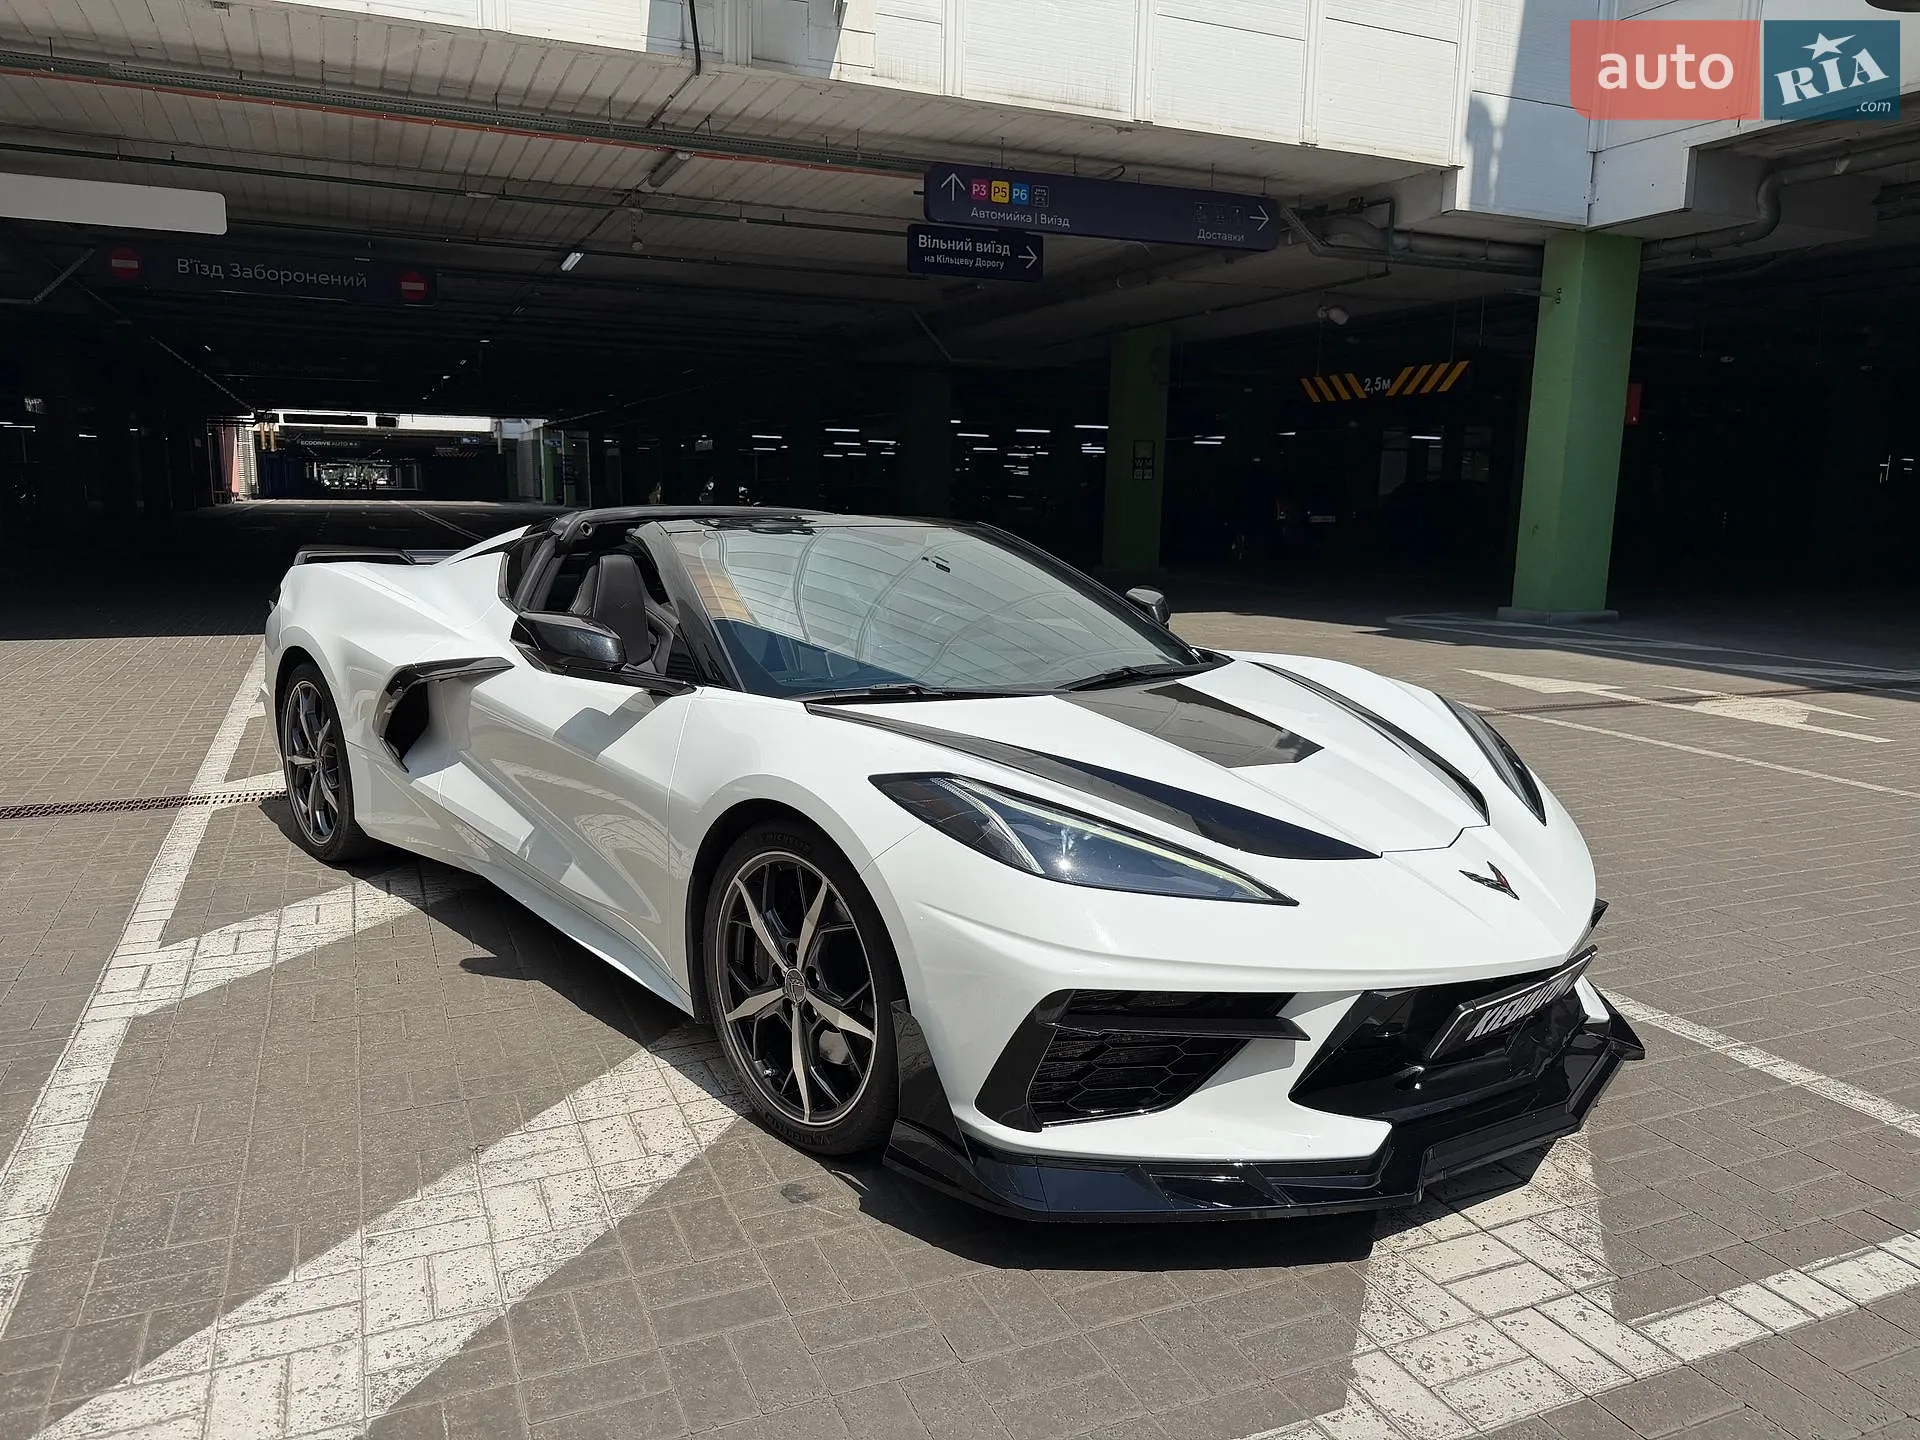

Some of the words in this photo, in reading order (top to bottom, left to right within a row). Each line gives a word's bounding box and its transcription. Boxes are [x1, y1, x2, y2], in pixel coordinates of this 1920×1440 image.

[972, 183, 987, 197] P3
[993, 185, 1008, 199] P5
[1013, 188, 1028, 202] P6
[970, 207, 1032, 224] Автомийка
[1040, 213, 1070, 228] Виїзд
[1198, 228, 1244, 242] Доставки
[917, 234, 974, 252] Вільний
[975, 240, 1011, 257] виїзд
[924, 256, 935, 264] на
[936, 254, 974, 269] Кільцеву
[975, 258, 1004, 270] Дорогу
[176, 257, 224, 280] В'їзд
[229, 262, 368, 289] Заборонений
